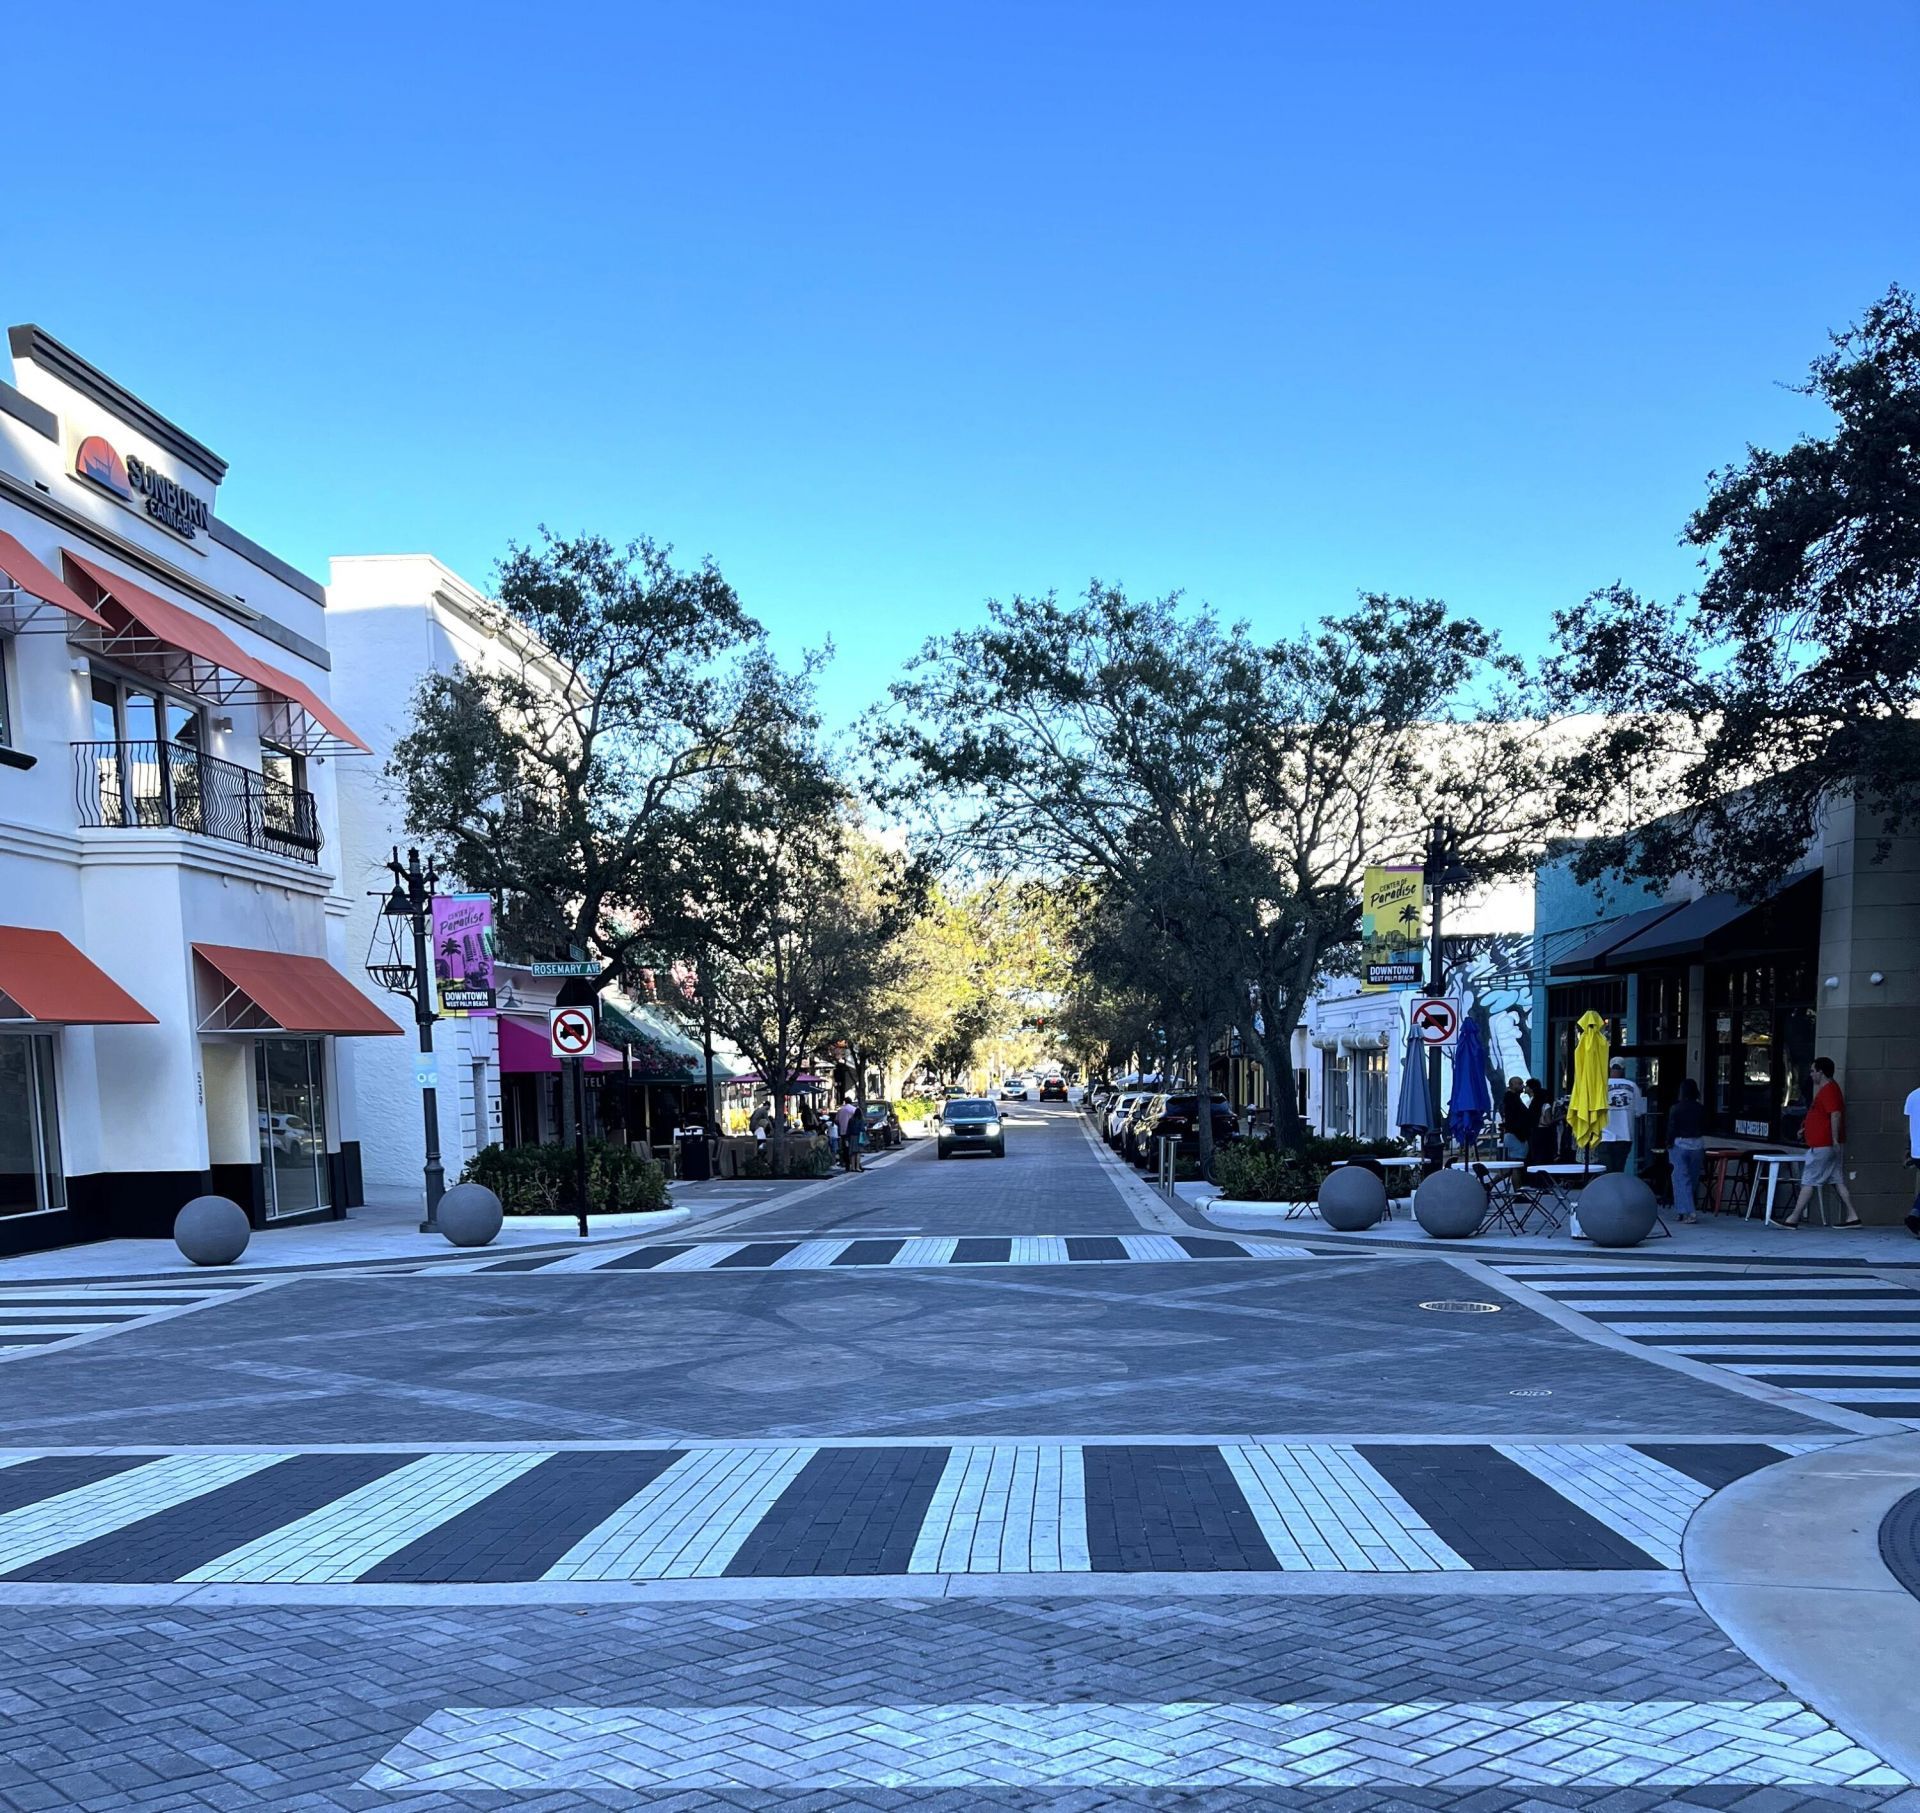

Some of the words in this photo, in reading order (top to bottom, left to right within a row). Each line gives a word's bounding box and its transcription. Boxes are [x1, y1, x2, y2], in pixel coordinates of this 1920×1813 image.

[126, 454, 208, 531] SUNBURN
[146, 498, 196, 539] CANNABIS
[1380, 881, 1401, 892] CENTER
[1370, 884, 1416, 908] Paradise
[440, 911, 485, 936] Paradise
[534, 964, 582, 975] ROSEMARY
[587, 963, 600, 974] AVE
[1370, 965, 1414, 976] DOWNTOWN
[445, 991, 488, 1001] DOWNTOWN
